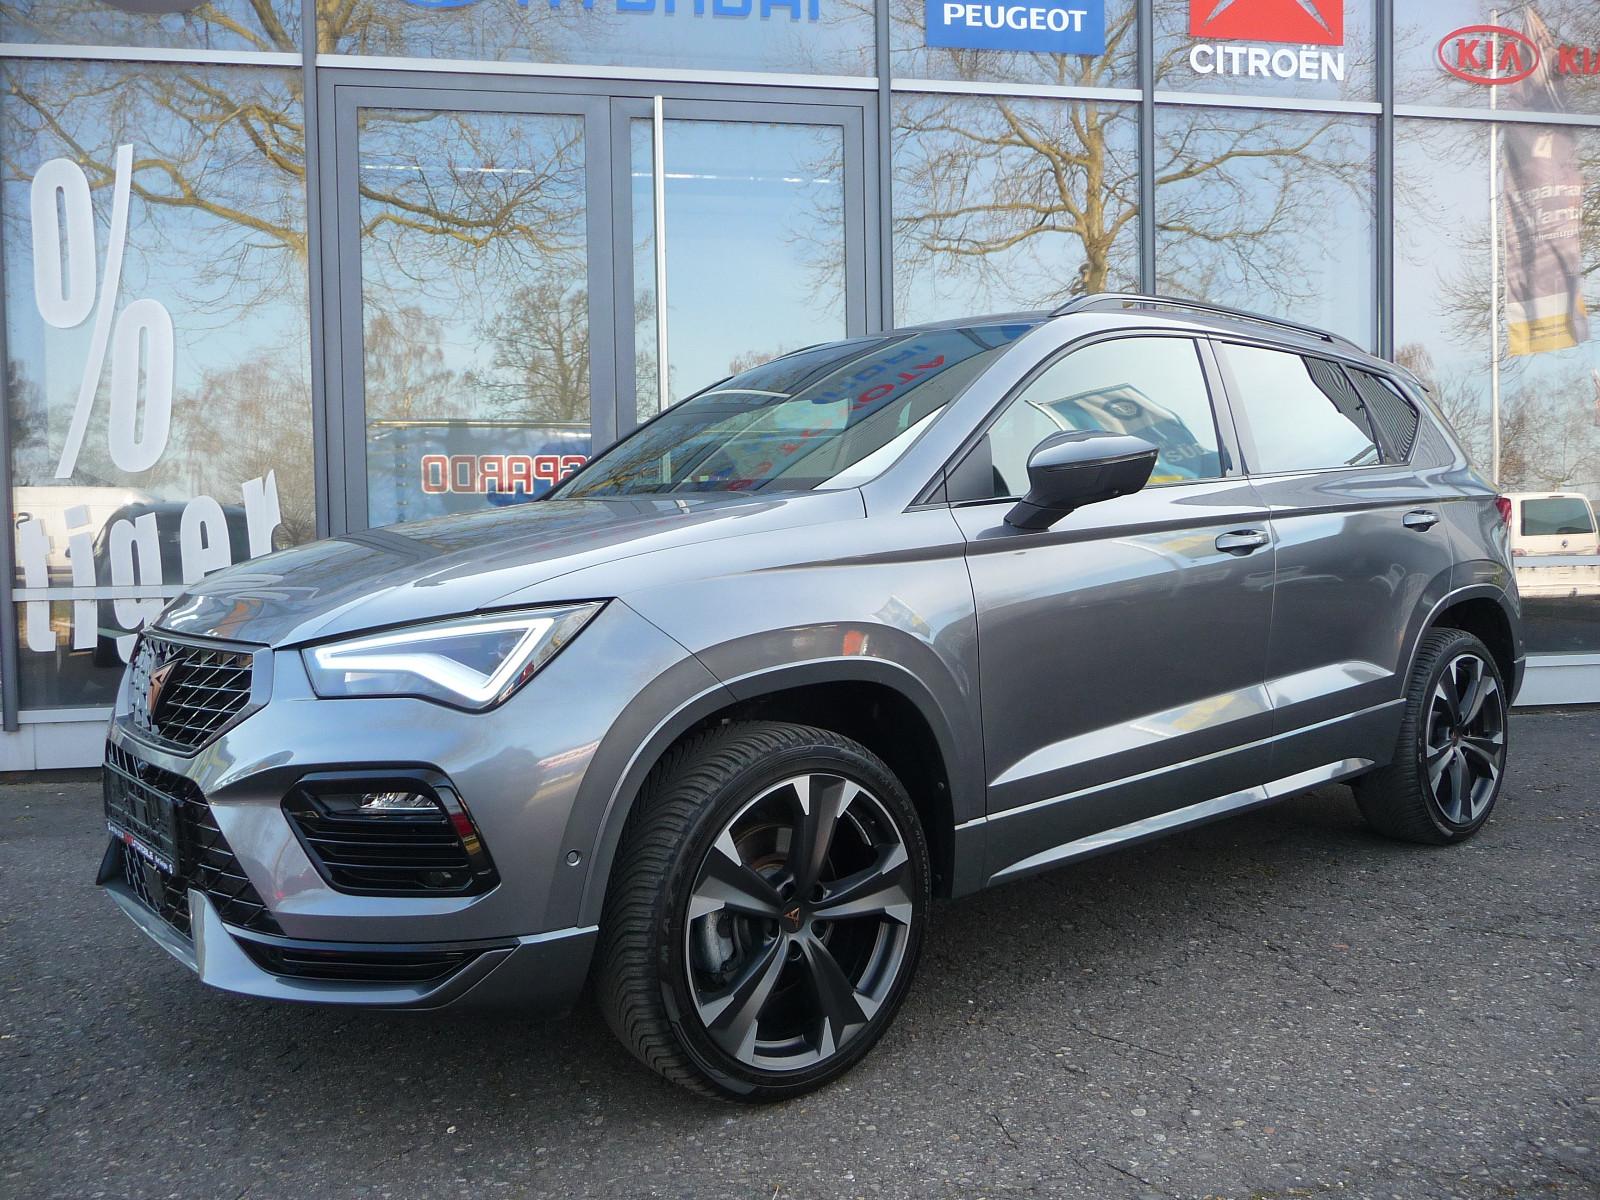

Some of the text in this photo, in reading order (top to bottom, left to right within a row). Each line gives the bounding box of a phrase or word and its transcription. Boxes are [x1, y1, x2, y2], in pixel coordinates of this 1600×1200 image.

[943, 3, 1088, 32] PEUGEOT
[1189, 43, 1344, 81] CITROËN
[1457, 38, 1523, 71] KIA
[19, 469, 282, 663] tiger
